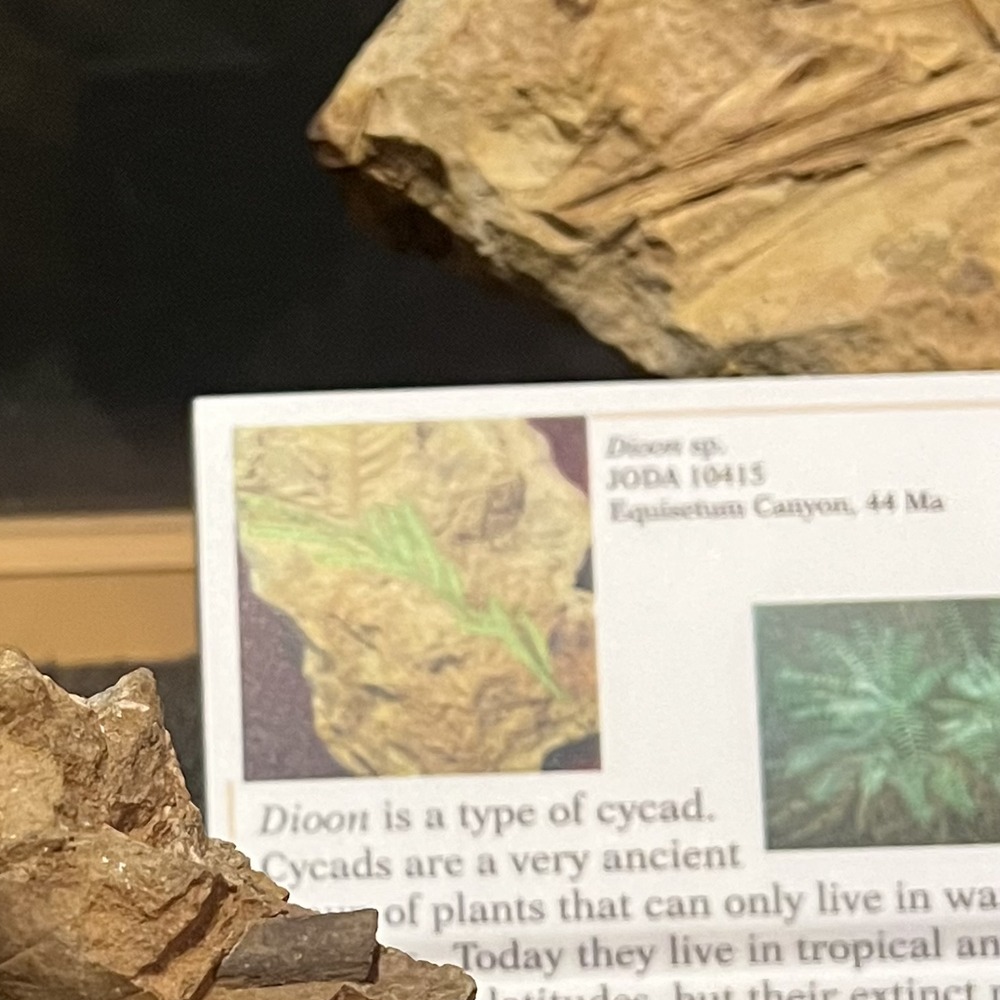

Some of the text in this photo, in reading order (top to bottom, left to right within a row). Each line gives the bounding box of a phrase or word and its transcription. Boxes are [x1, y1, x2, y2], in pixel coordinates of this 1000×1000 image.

[605, 465, 680, 490] JODA
[864, 491, 897, 513] 44
[903, 490, 946, 514] Ma
[259, 788, 714, 838] Dioon is a type of cycad.
[261, 839, 744, 888] Cycads are a very ancient
[384, 892, 422, 927] of
[433, 891, 545, 933] plants
[559, 888, 632, 922] that
[644, 895, 711, 921] can
[724, 882, 803, 924] only
[816, 881, 882, 913] live
[896, 881, 932, 913] in
[453, 939, 564, 977] Today
[577, 936, 657, 975] they
[669, 933, 735, 967] live
[748, 933, 784, 965] in
[798, 926, 943, 969] tropical
